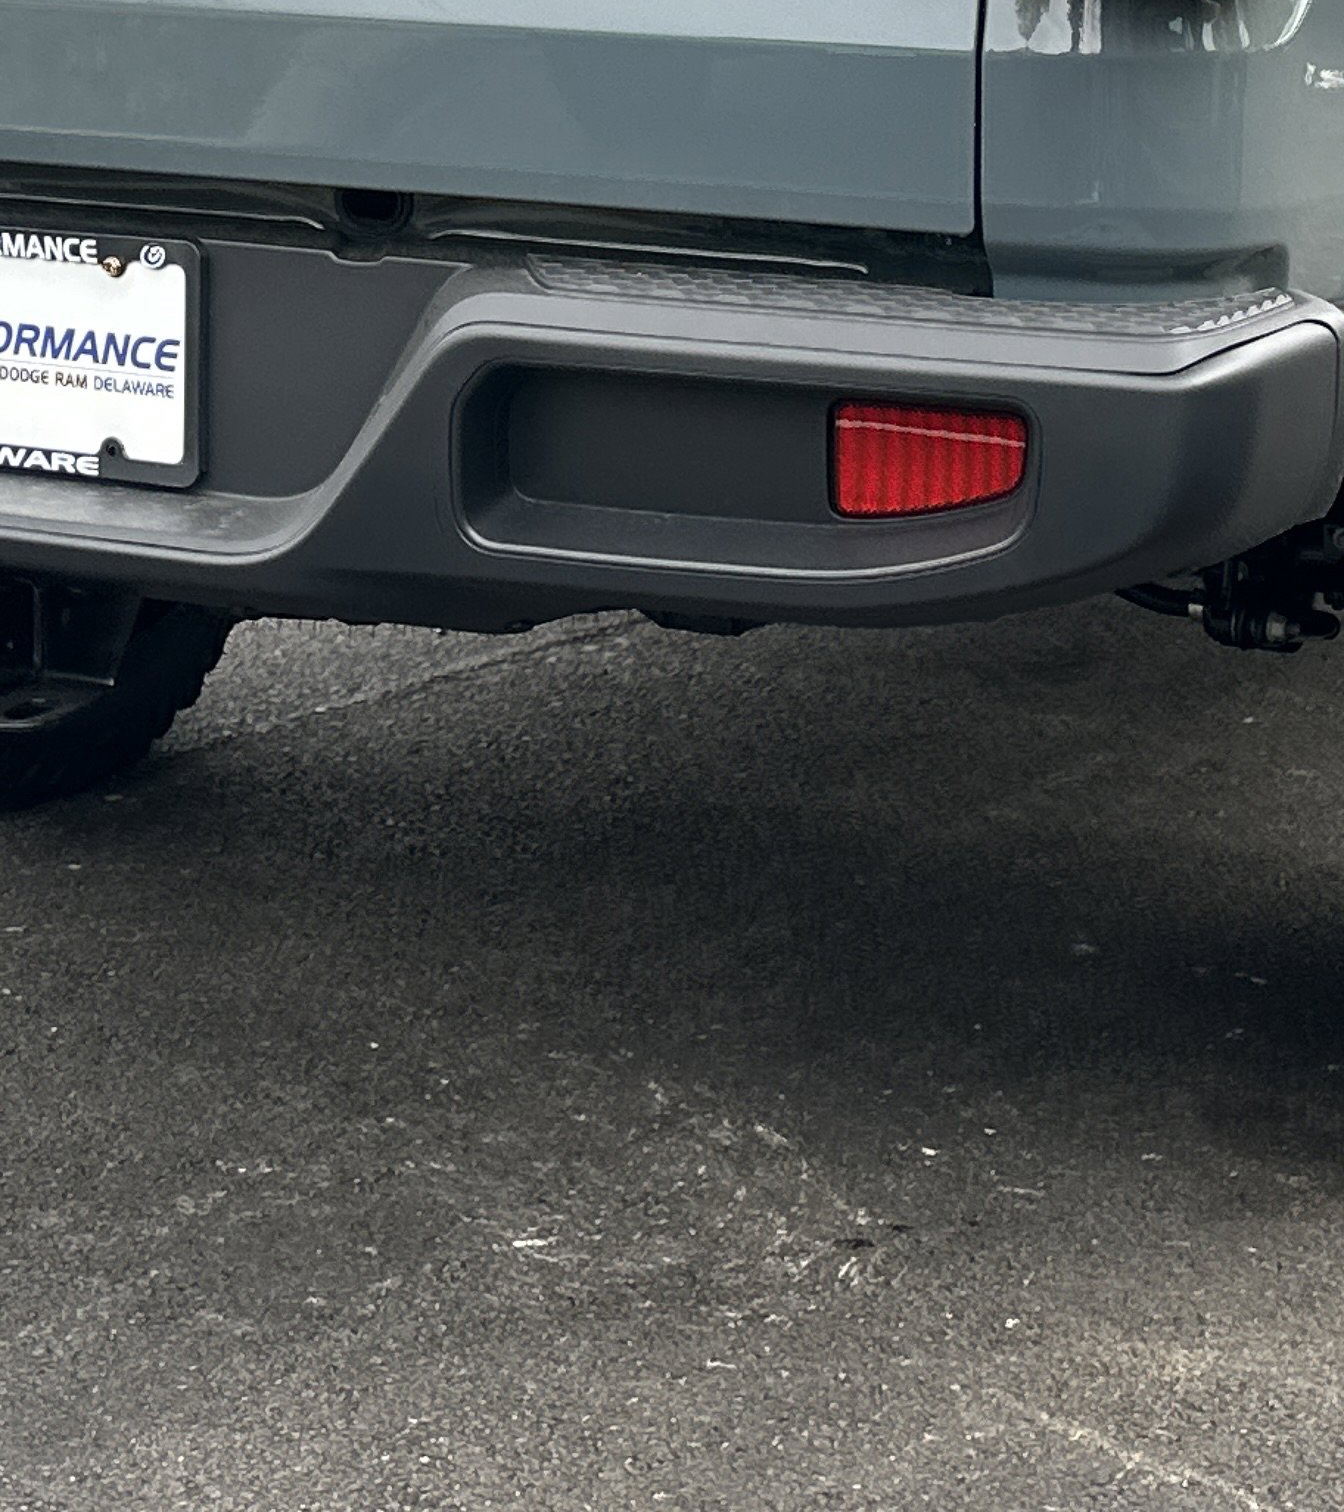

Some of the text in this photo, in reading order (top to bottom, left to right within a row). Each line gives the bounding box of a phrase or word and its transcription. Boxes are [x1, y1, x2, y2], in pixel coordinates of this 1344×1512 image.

[0, 366, 50, 386] DODGE
[55, 371, 88, 390] RAM
[93, 375, 175, 400] DELAWARE
